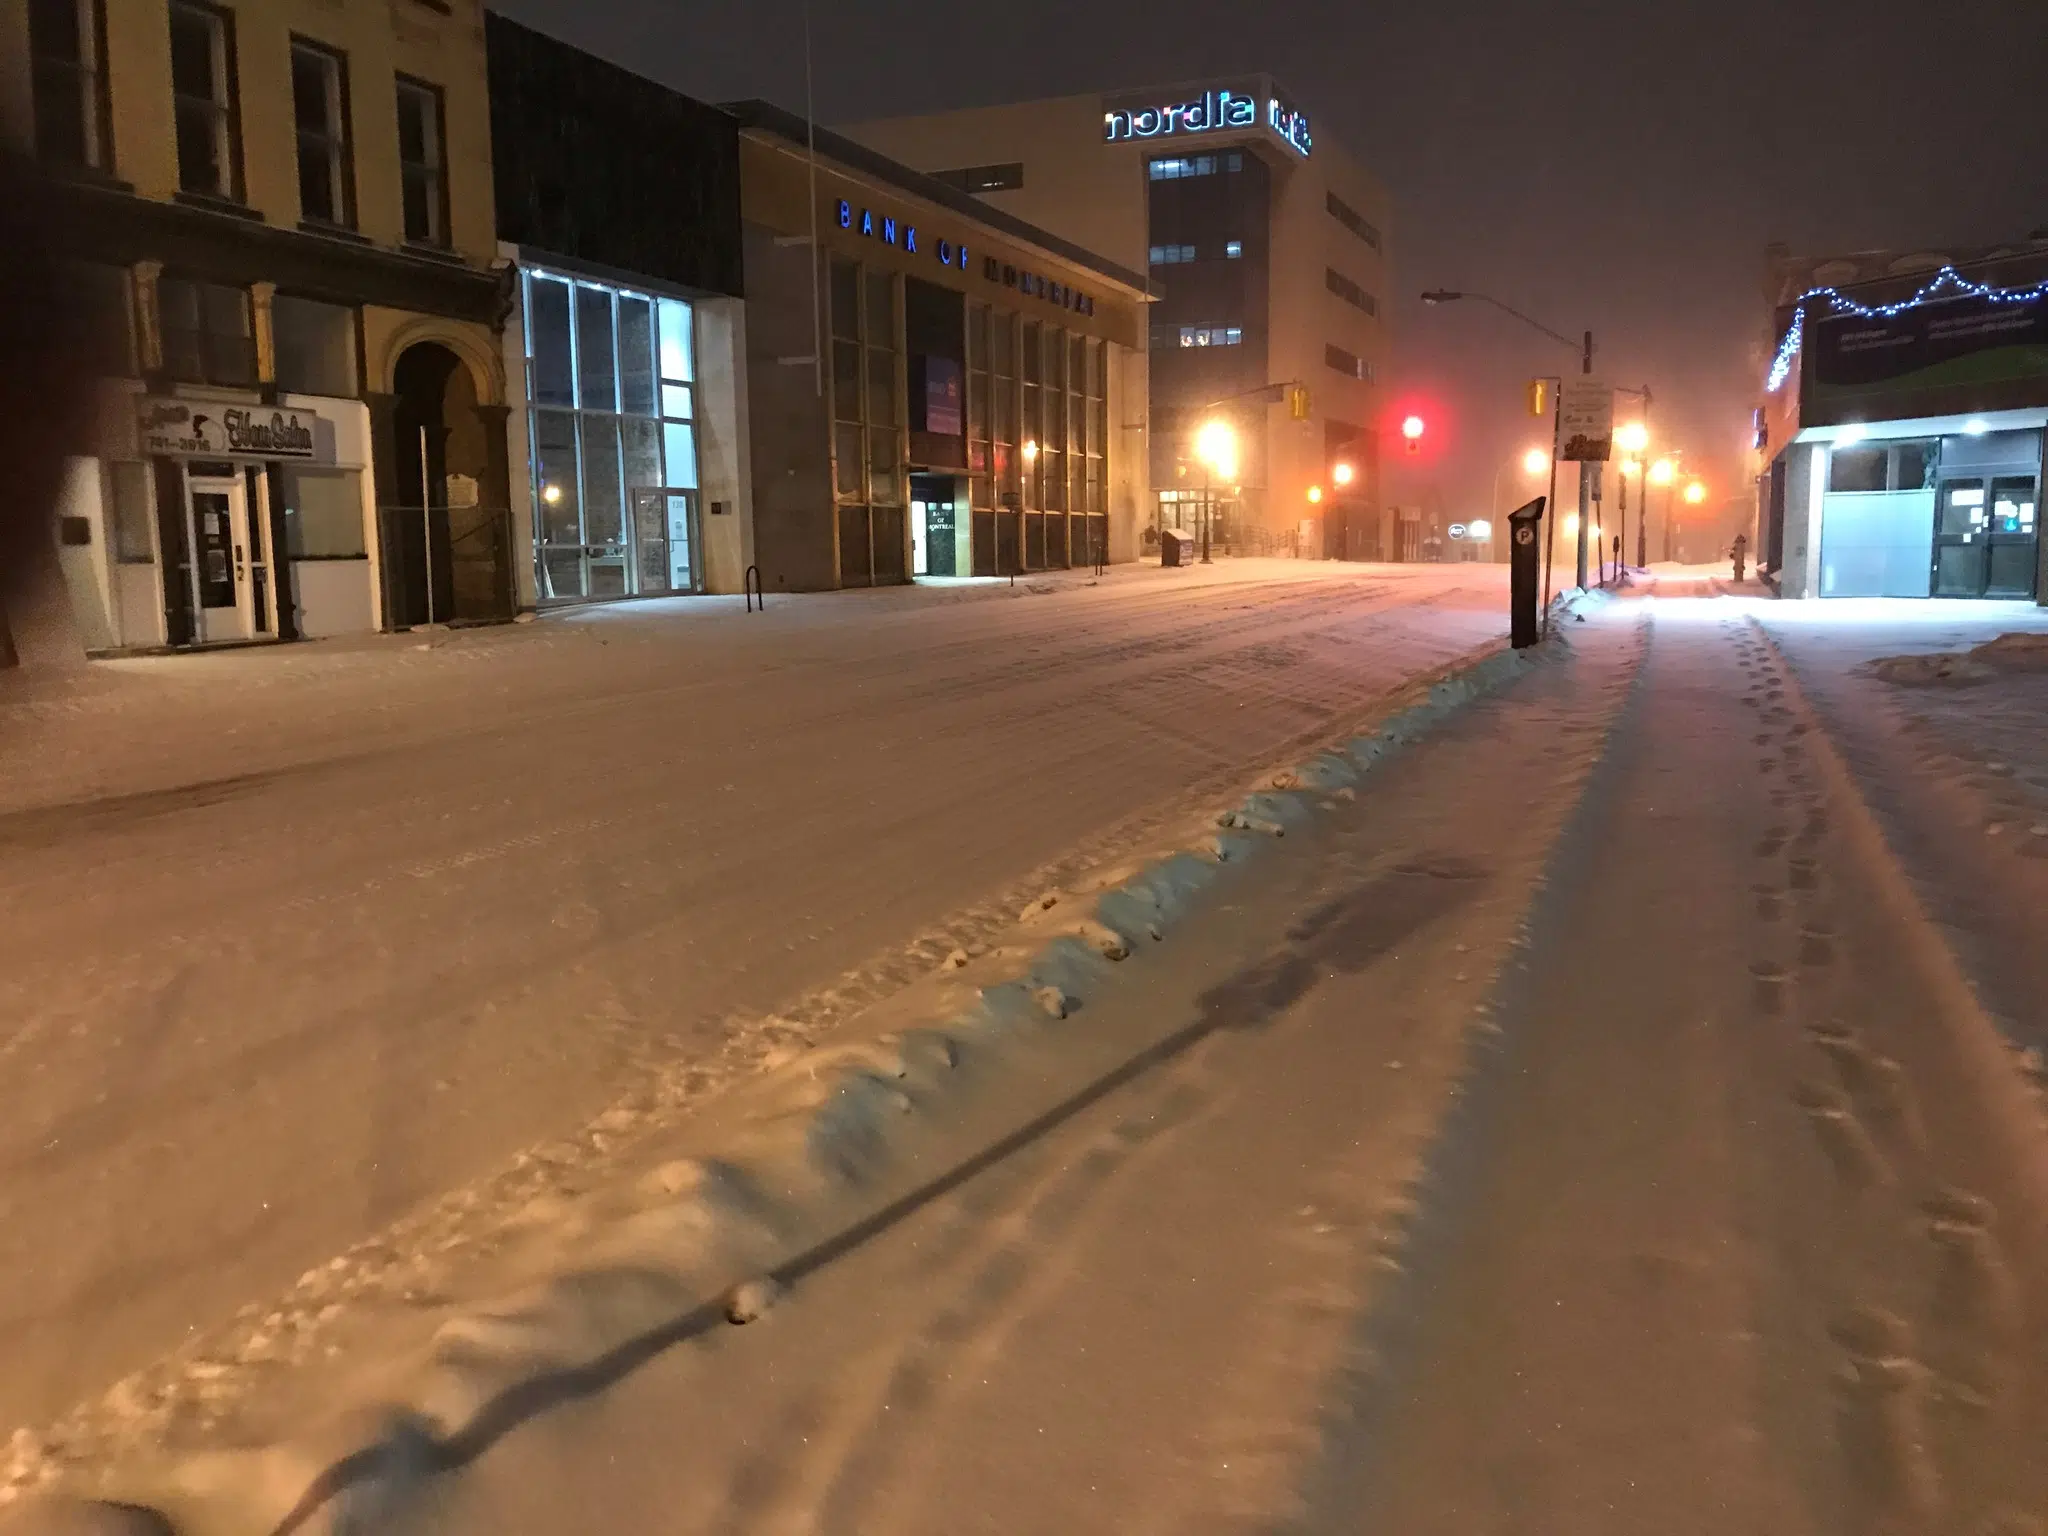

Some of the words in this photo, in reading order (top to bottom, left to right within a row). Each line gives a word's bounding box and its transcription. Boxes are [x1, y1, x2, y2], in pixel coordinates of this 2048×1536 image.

[1105, 91, 1254, 139] nordia
[838, 199, 916, 253] BANK
[939, 239, 968, 270] OF
[1521, 530, 1530, 541] P
